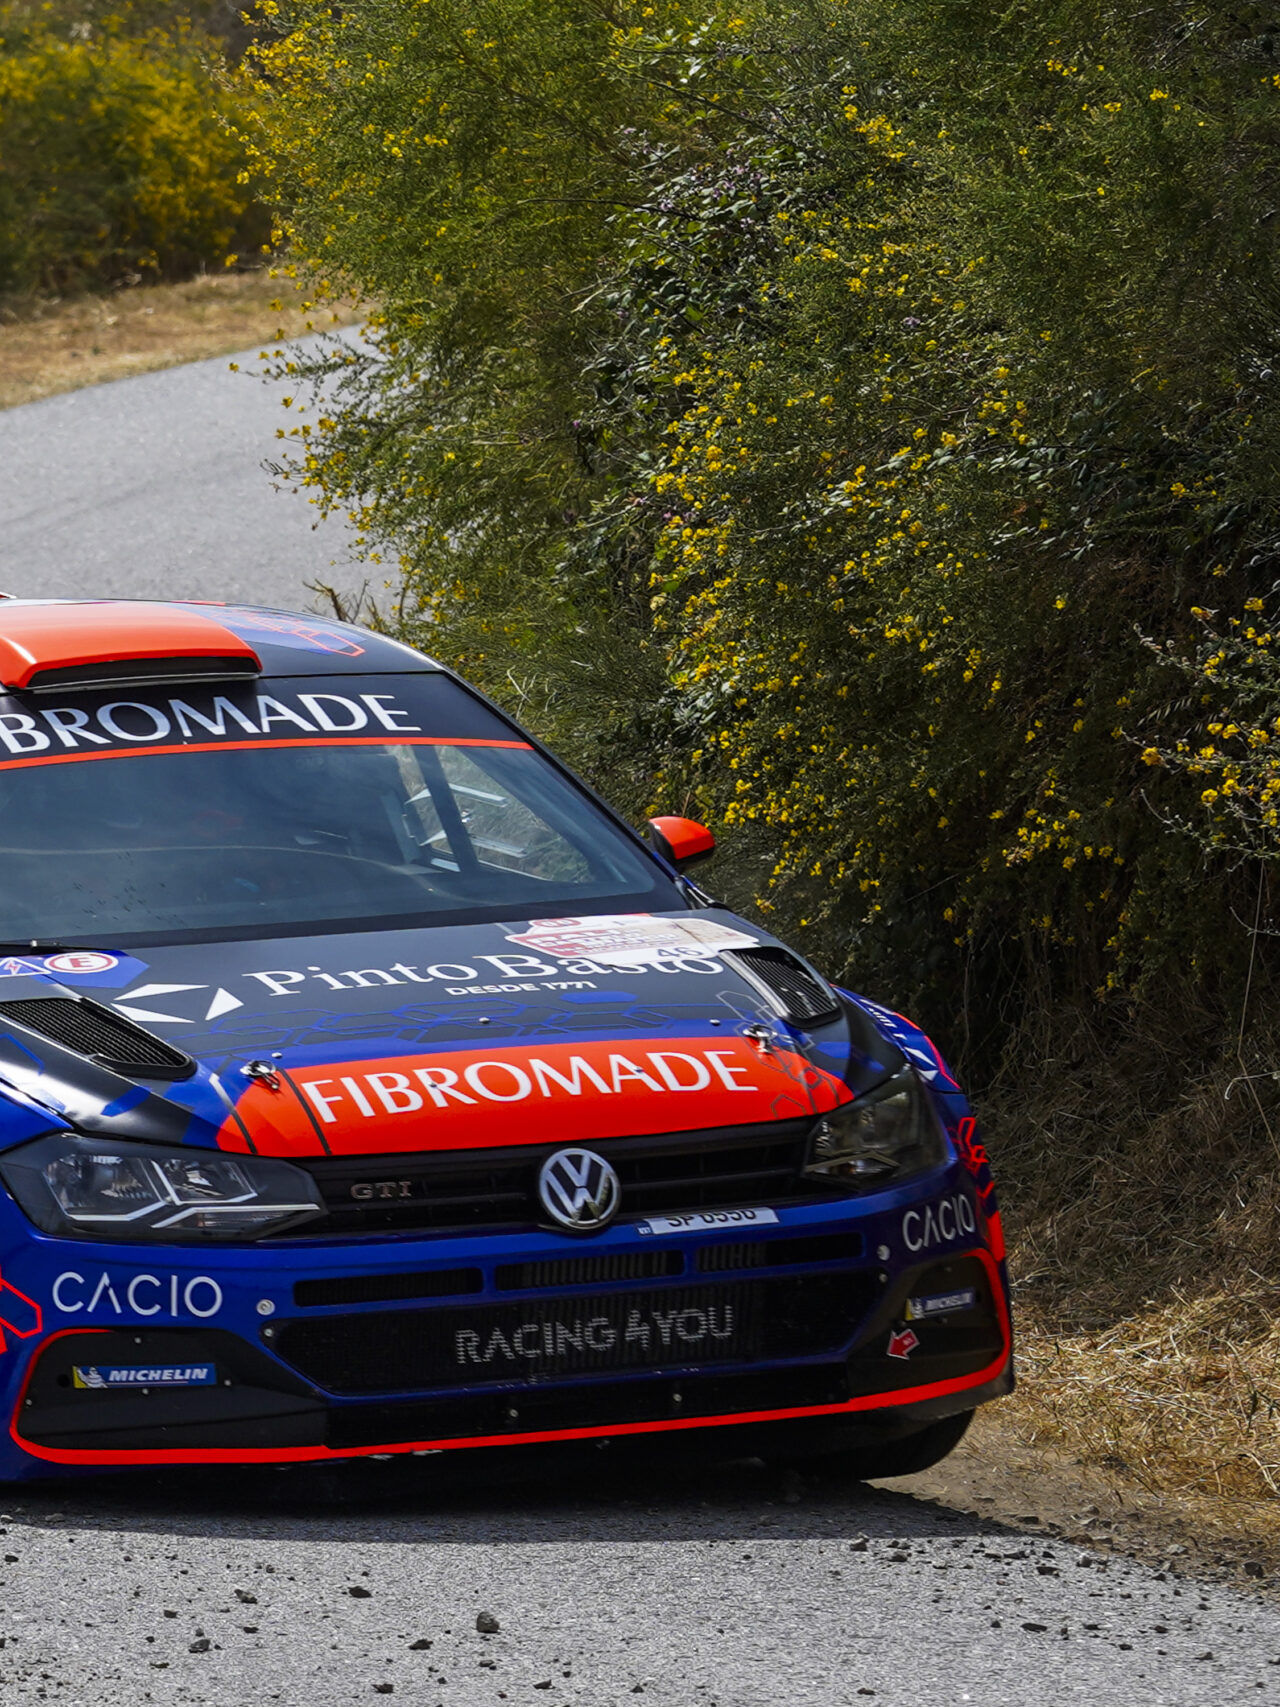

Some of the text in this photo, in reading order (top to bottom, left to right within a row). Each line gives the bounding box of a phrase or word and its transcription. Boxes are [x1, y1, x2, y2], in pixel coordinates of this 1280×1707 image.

[242, 960, 479, 998] Pinto
[444, 980, 598, 996] DESDE 1771
[300, 1050, 758, 1124] FIBROMADE
[350, 1181, 412, 1200] GTI
[902, 1194, 975, 1252] CACIO
[52, 1271, 223, 1318] CACIO
[455, 1317, 617, 1364] RACING
[108, 1367, 209, 1382] MICHELIN
